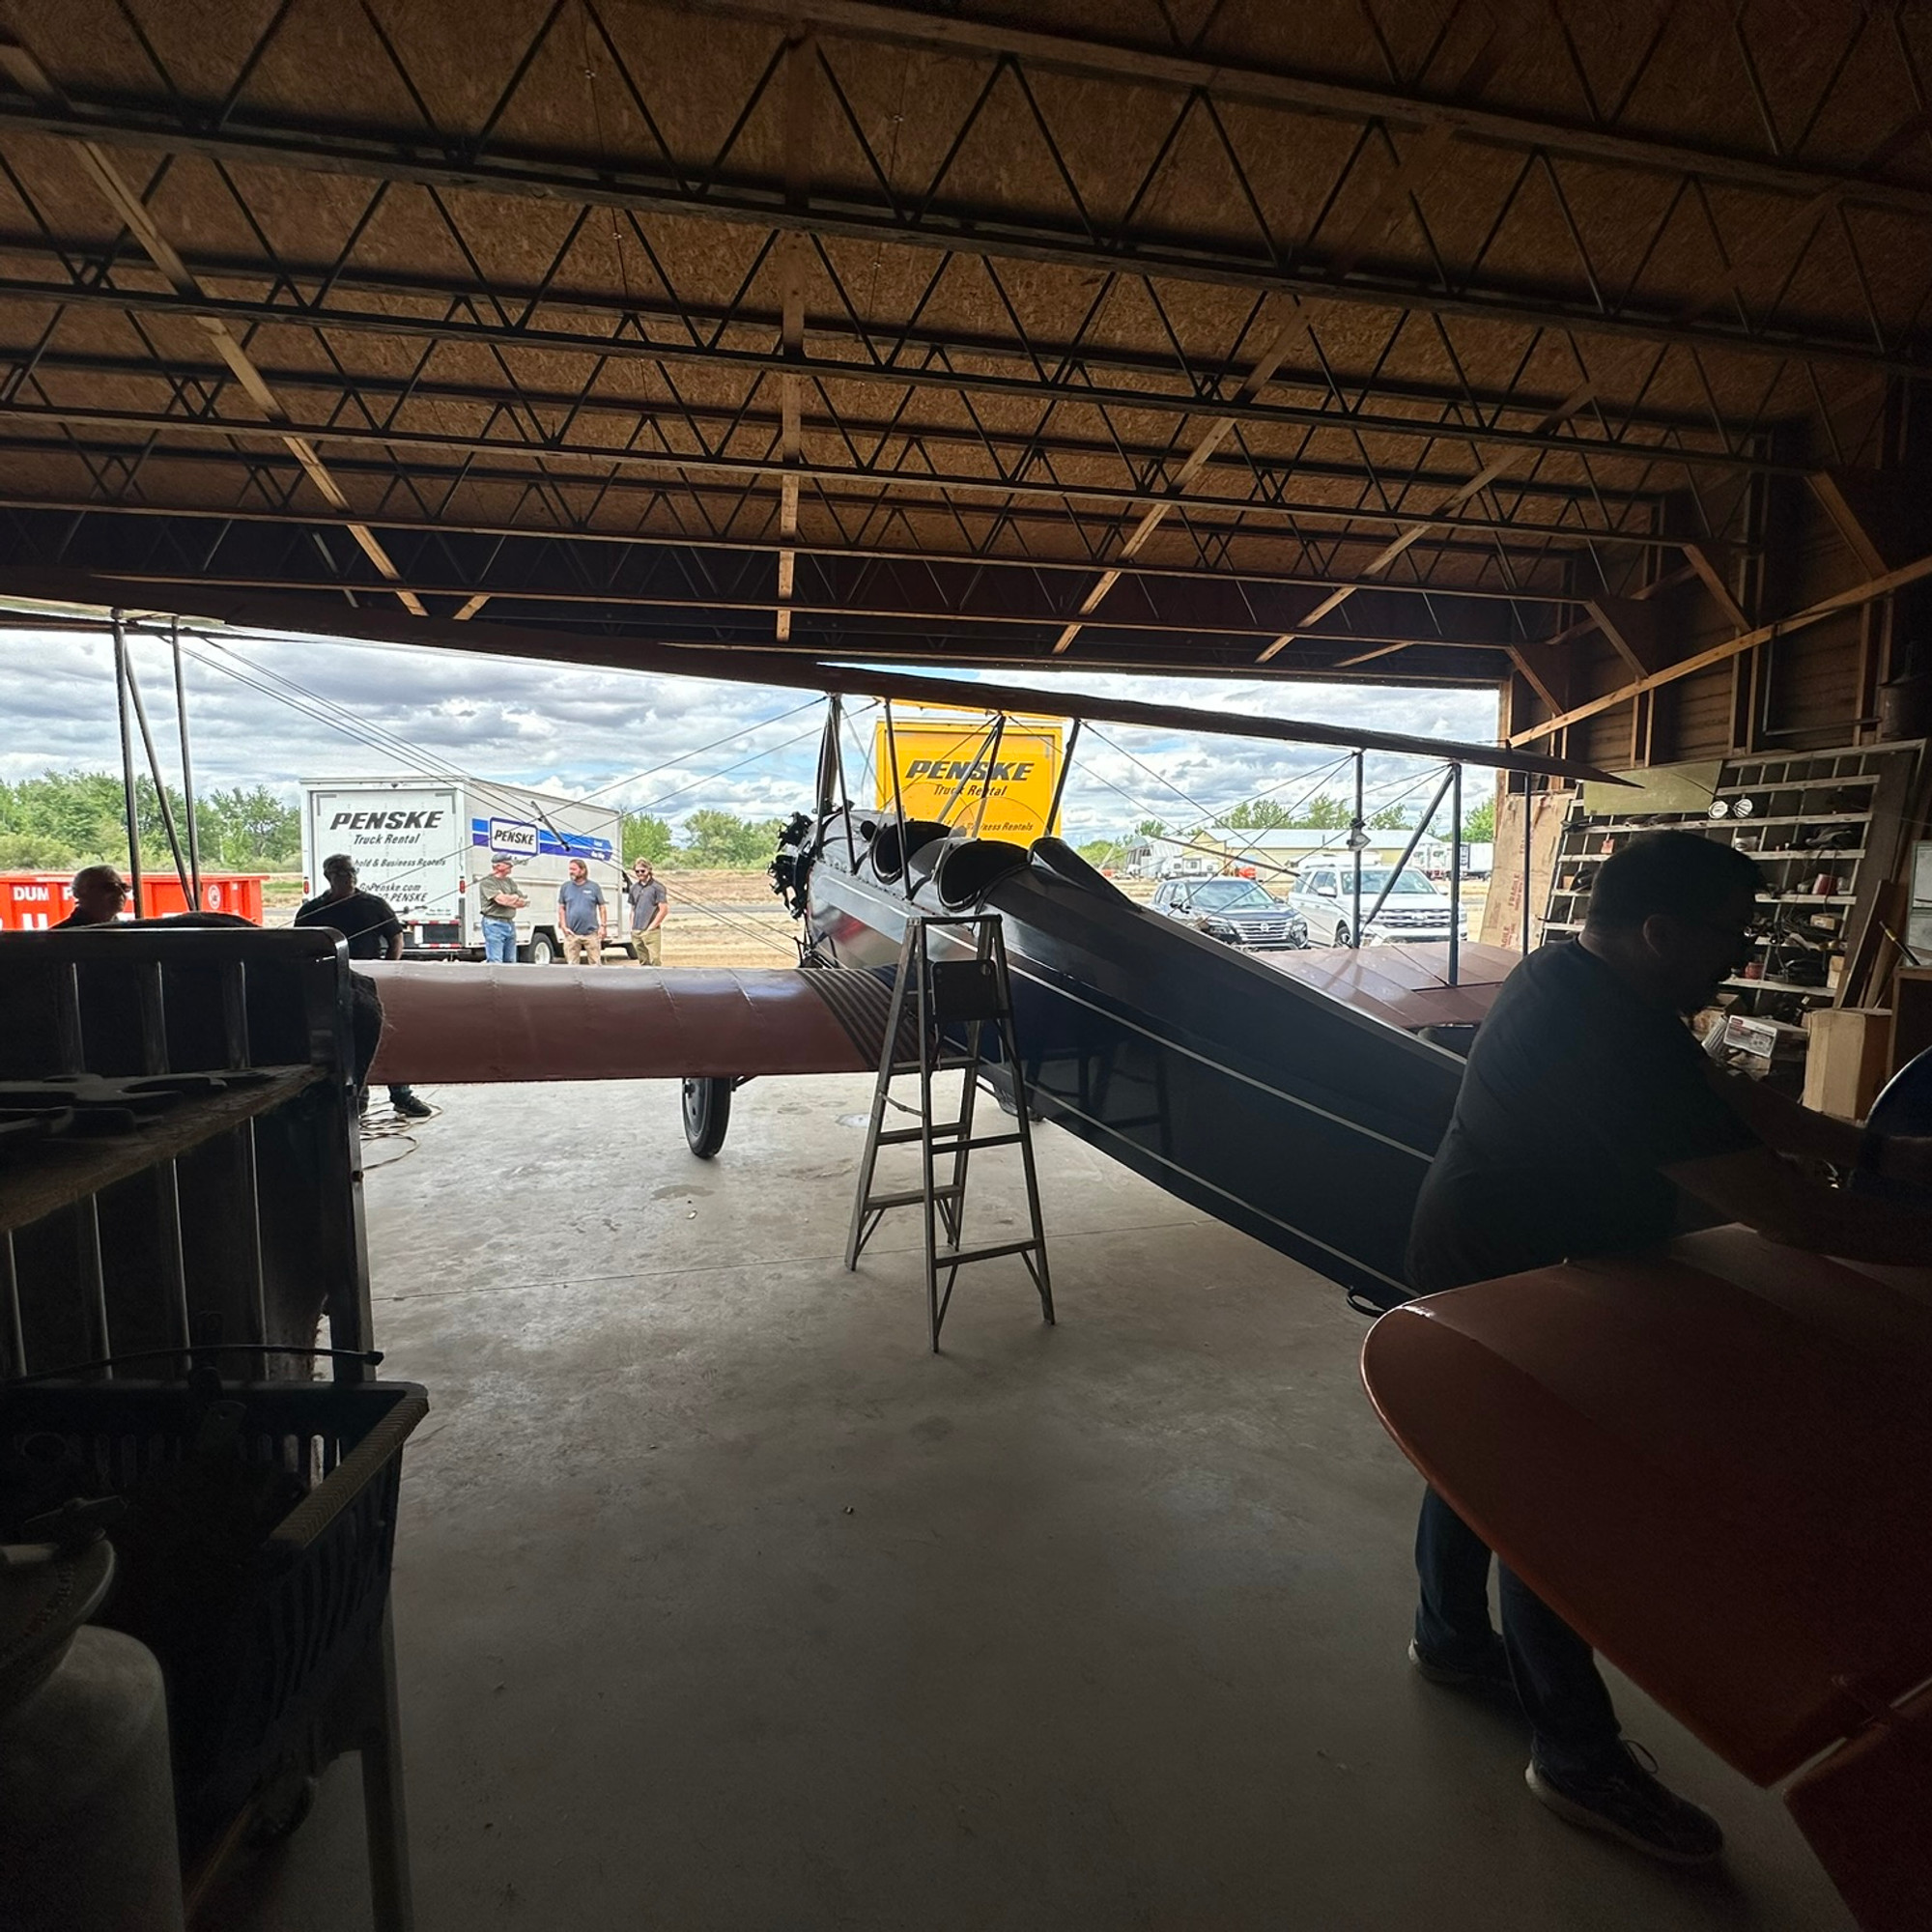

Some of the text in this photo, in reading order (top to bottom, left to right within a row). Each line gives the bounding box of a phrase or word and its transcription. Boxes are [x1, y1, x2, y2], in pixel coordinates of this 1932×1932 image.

[905, 760, 1035, 781] PENSKE
[968, 784, 1008, 797] Retal
[329, 810, 444, 830] PENSKE
[354, 833, 421, 845] Truck Rental
[494, 829, 535, 846] PENSKE
[381, 858, 416, 867] Business
